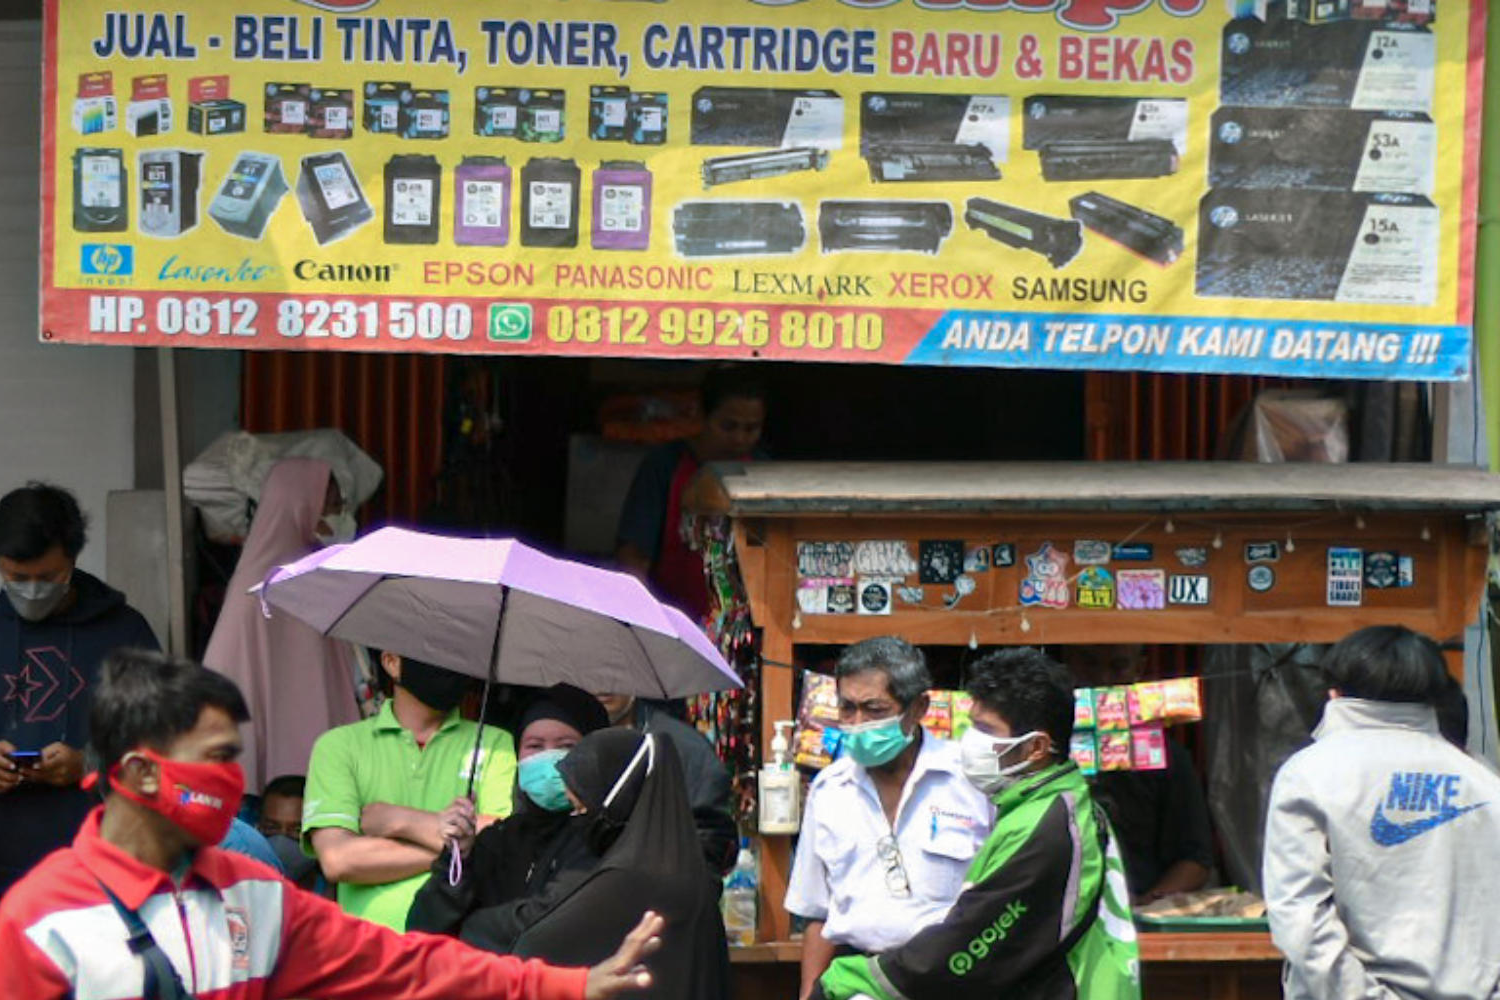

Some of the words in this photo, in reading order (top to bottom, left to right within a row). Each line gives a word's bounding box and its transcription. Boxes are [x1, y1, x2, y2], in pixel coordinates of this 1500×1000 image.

[93, 13, 196, 58] JUAL
[234, 16, 322, 60] BELI
[337, 18, 468, 73] TINTA,
[481, 21, 629, 77] TONER,
[644, 25, 875, 74] CARTRIDGE
[890, 31, 999, 78] BARU
[1015, 34, 1042, 78] &
[1059, 36, 1193, 83] BEKAS
[1369, 219, 1399, 233] 15A
[293, 259, 392, 282] Canon
[423, 261, 535, 286] EPSON
[555, 264, 713, 291] PANASONIC
[732, 270, 873, 297] LEXMARK
[888, 272, 994, 300] XEROX
[1012, 276, 1148, 304] SAMSUNG
[89, 295, 147, 333] HP.
[157, 297, 259, 337] 0812
[547, 305, 650, 345] 0812
[658, 307, 771, 348] 9926
[779, 311, 885, 351] 8010
[941, 319, 1031, 352] ANDA
[1043, 321, 1172, 356] TELPON
[1177, 326, 1267, 358] KAMI
[1270, 329, 1400, 363] DATANG
[1386, 772, 1461, 813] NIKE
[968, 899, 1028, 960] gojek
